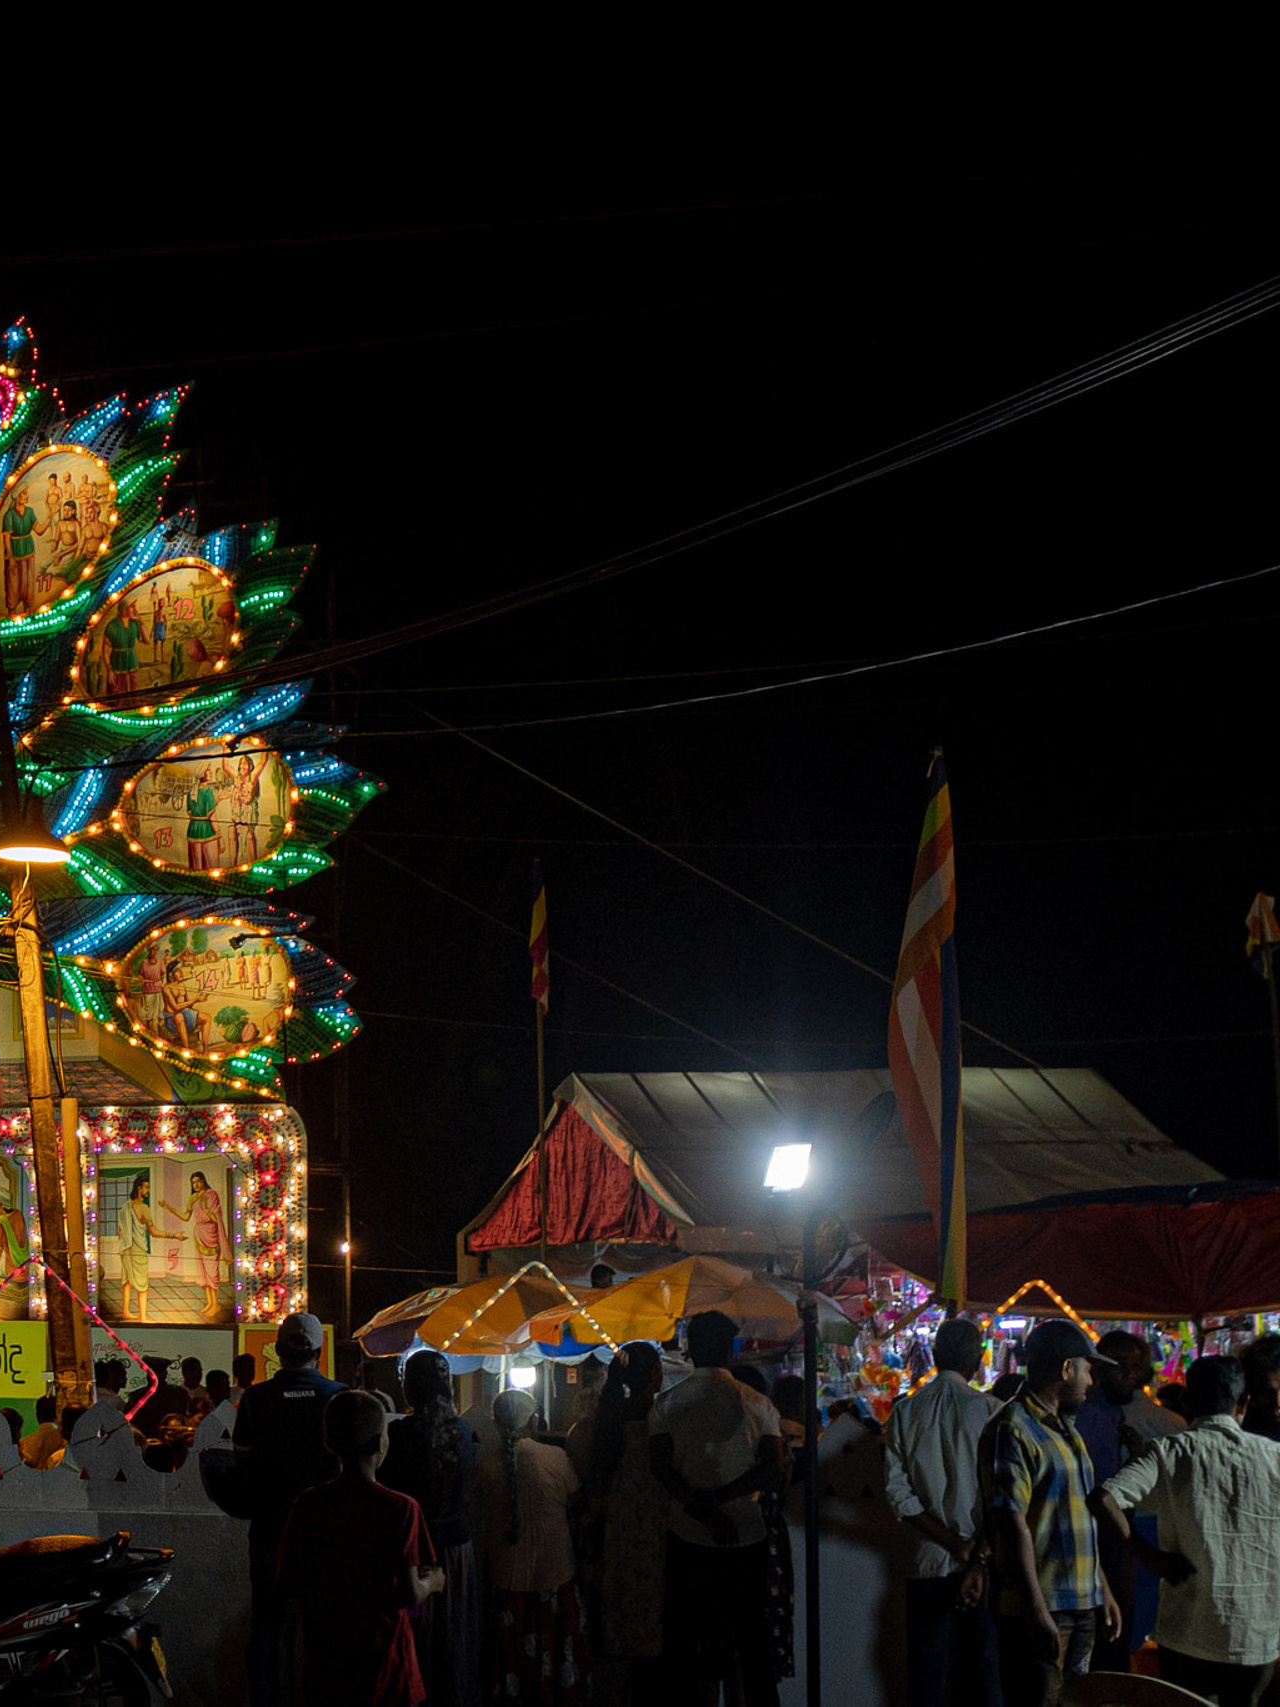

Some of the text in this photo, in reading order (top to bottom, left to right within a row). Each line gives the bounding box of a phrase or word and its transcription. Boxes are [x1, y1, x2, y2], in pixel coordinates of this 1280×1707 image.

[37, 574, 52, 593] 11
[173, 599, 195, 620] 12
[153, 827, 173, 849] 13
[196, 969, 218, 992] 14
[168, 1248, 179, 1270] 5
